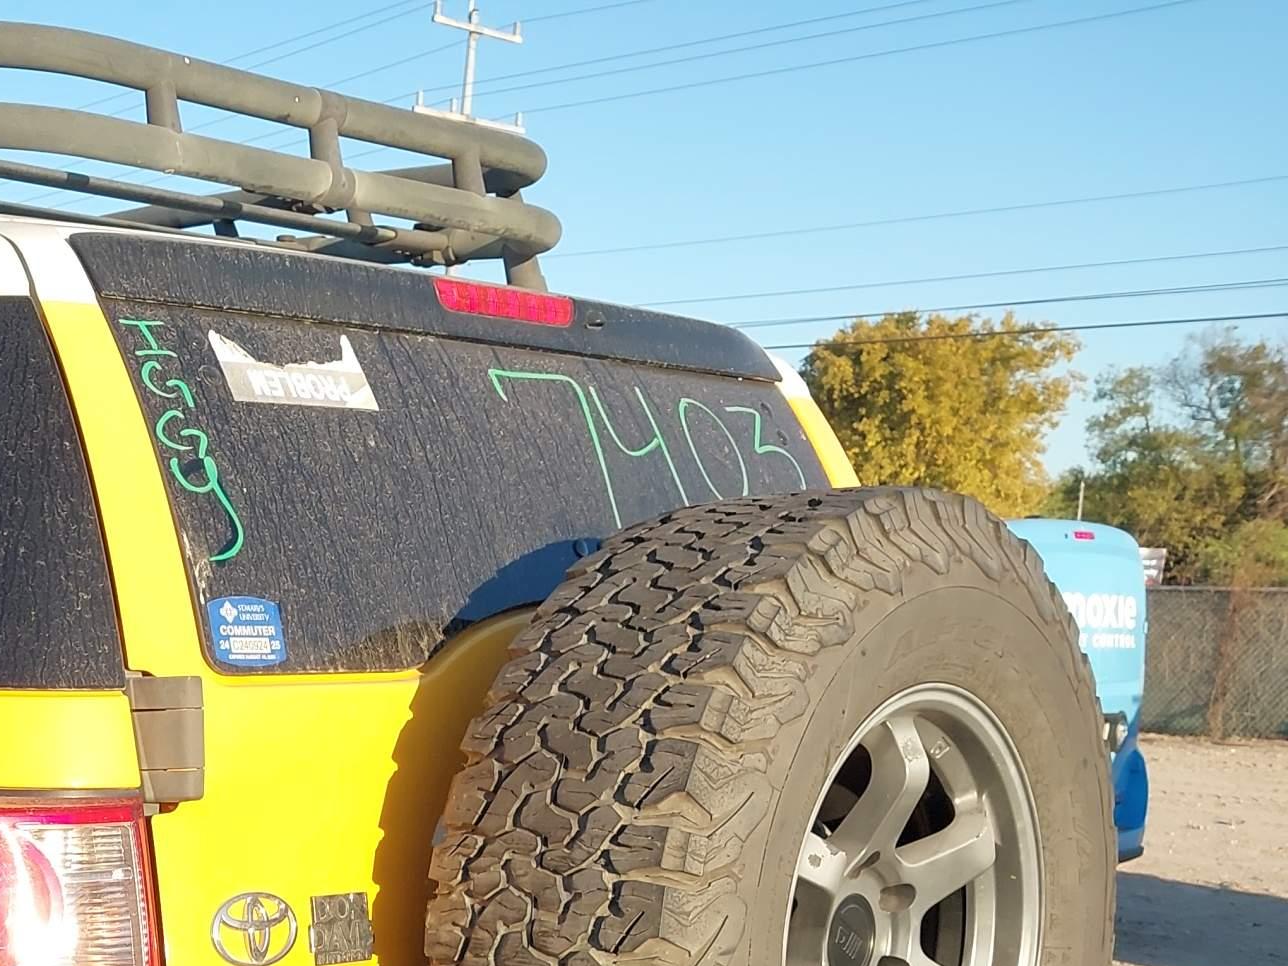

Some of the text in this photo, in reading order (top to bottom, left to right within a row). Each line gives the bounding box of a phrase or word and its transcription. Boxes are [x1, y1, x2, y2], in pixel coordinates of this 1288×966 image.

[488, 369, 807, 529] 7403
[220, 625, 276, 636] COMMUTER
[219, 639, 230, 650] 24
[270, 640, 281, 650] 25
